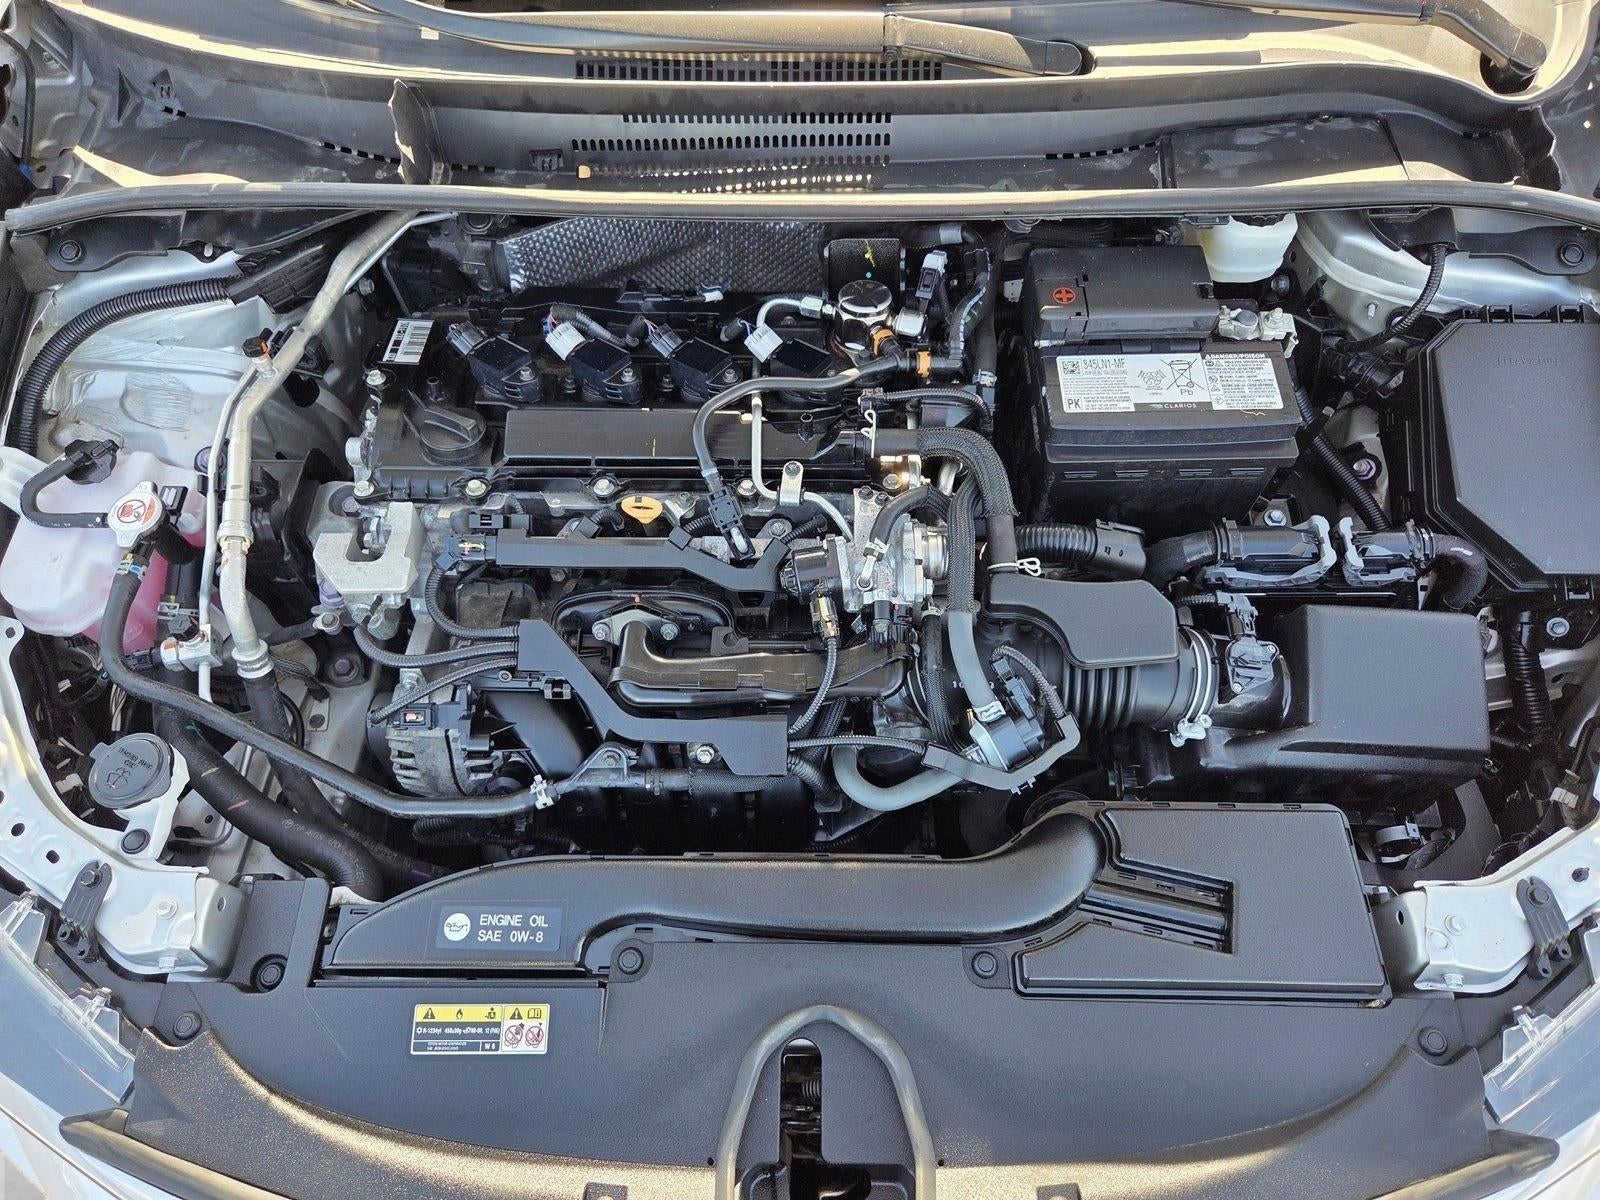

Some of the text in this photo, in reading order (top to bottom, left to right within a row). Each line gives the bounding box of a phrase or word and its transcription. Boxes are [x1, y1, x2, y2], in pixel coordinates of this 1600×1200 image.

[1180, 388, 1194, 396] Pb
[1067, 398, 1081, 409] PK
[480, 914, 549, 927] ENGINE OIL
[477, 929, 544, 943] SAE 0W-8
